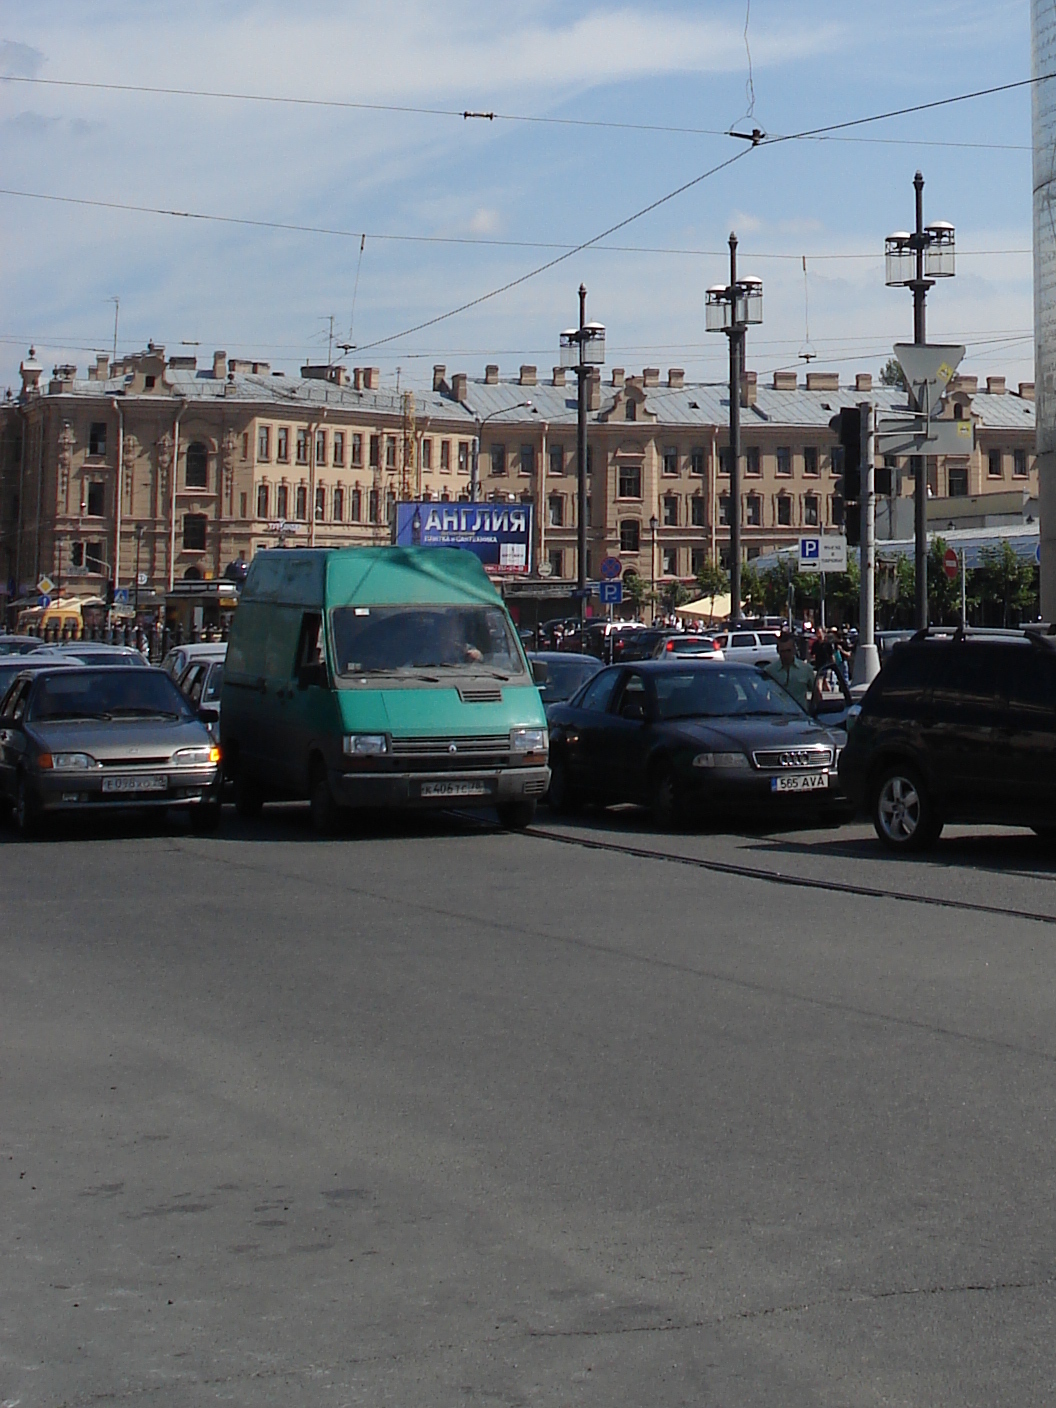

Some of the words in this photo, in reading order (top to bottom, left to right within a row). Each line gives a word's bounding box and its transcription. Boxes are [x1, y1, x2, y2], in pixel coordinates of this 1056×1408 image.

[424, 509, 525, 532] АНГЛИЯ
[780, 778, 799, 789] 565
[802, 775, 825, 787] AVA
